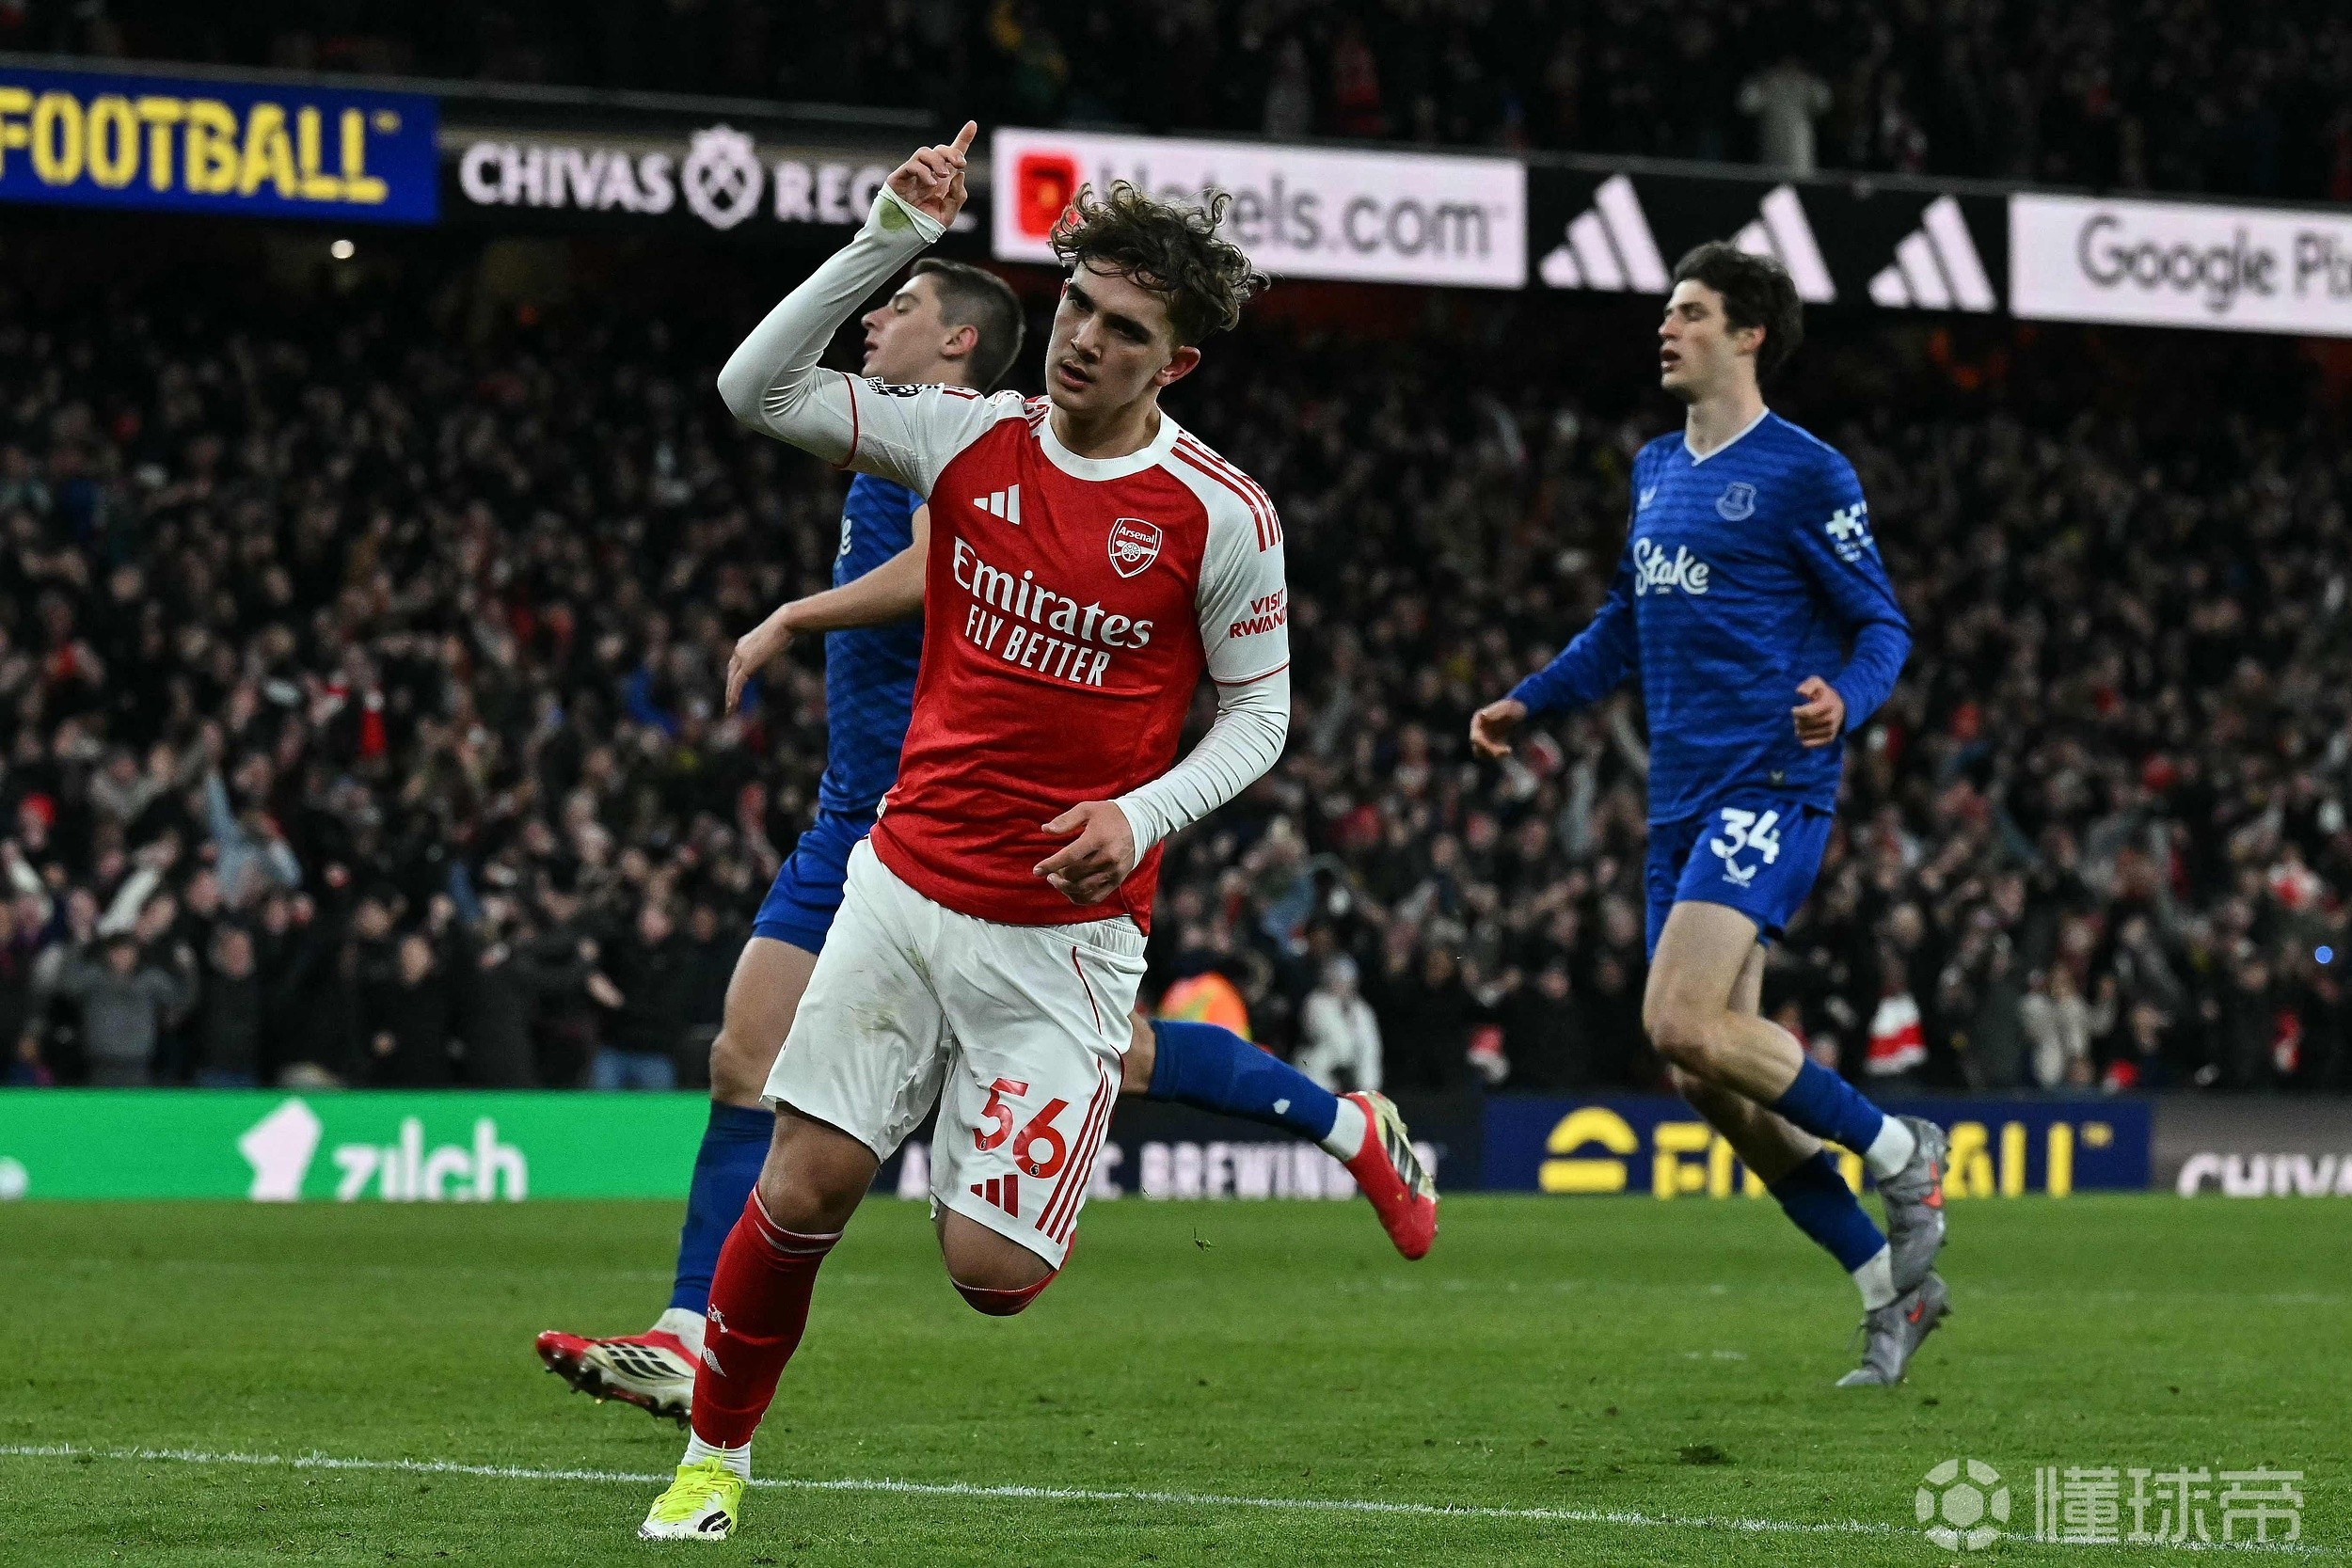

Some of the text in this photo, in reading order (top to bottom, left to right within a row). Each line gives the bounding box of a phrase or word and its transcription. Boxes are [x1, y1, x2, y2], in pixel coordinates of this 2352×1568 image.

[459, 140, 676, 215] CHIVAS
[2074, 214, 2277, 314] Google
[1119, 526, 1155, 544] Arsenal
[1632, 537, 1710, 597] Stake
[953, 535, 1154, 649] Emirates
[1249, 587, 1284, 615] VISIT
[964, 603, 1111, 688] FLY BETTER
[1709, 806, 1780, 864] 34
[331, 1117, 530, 1202] zilch
[972, 1077, 1070, 1180] 56
